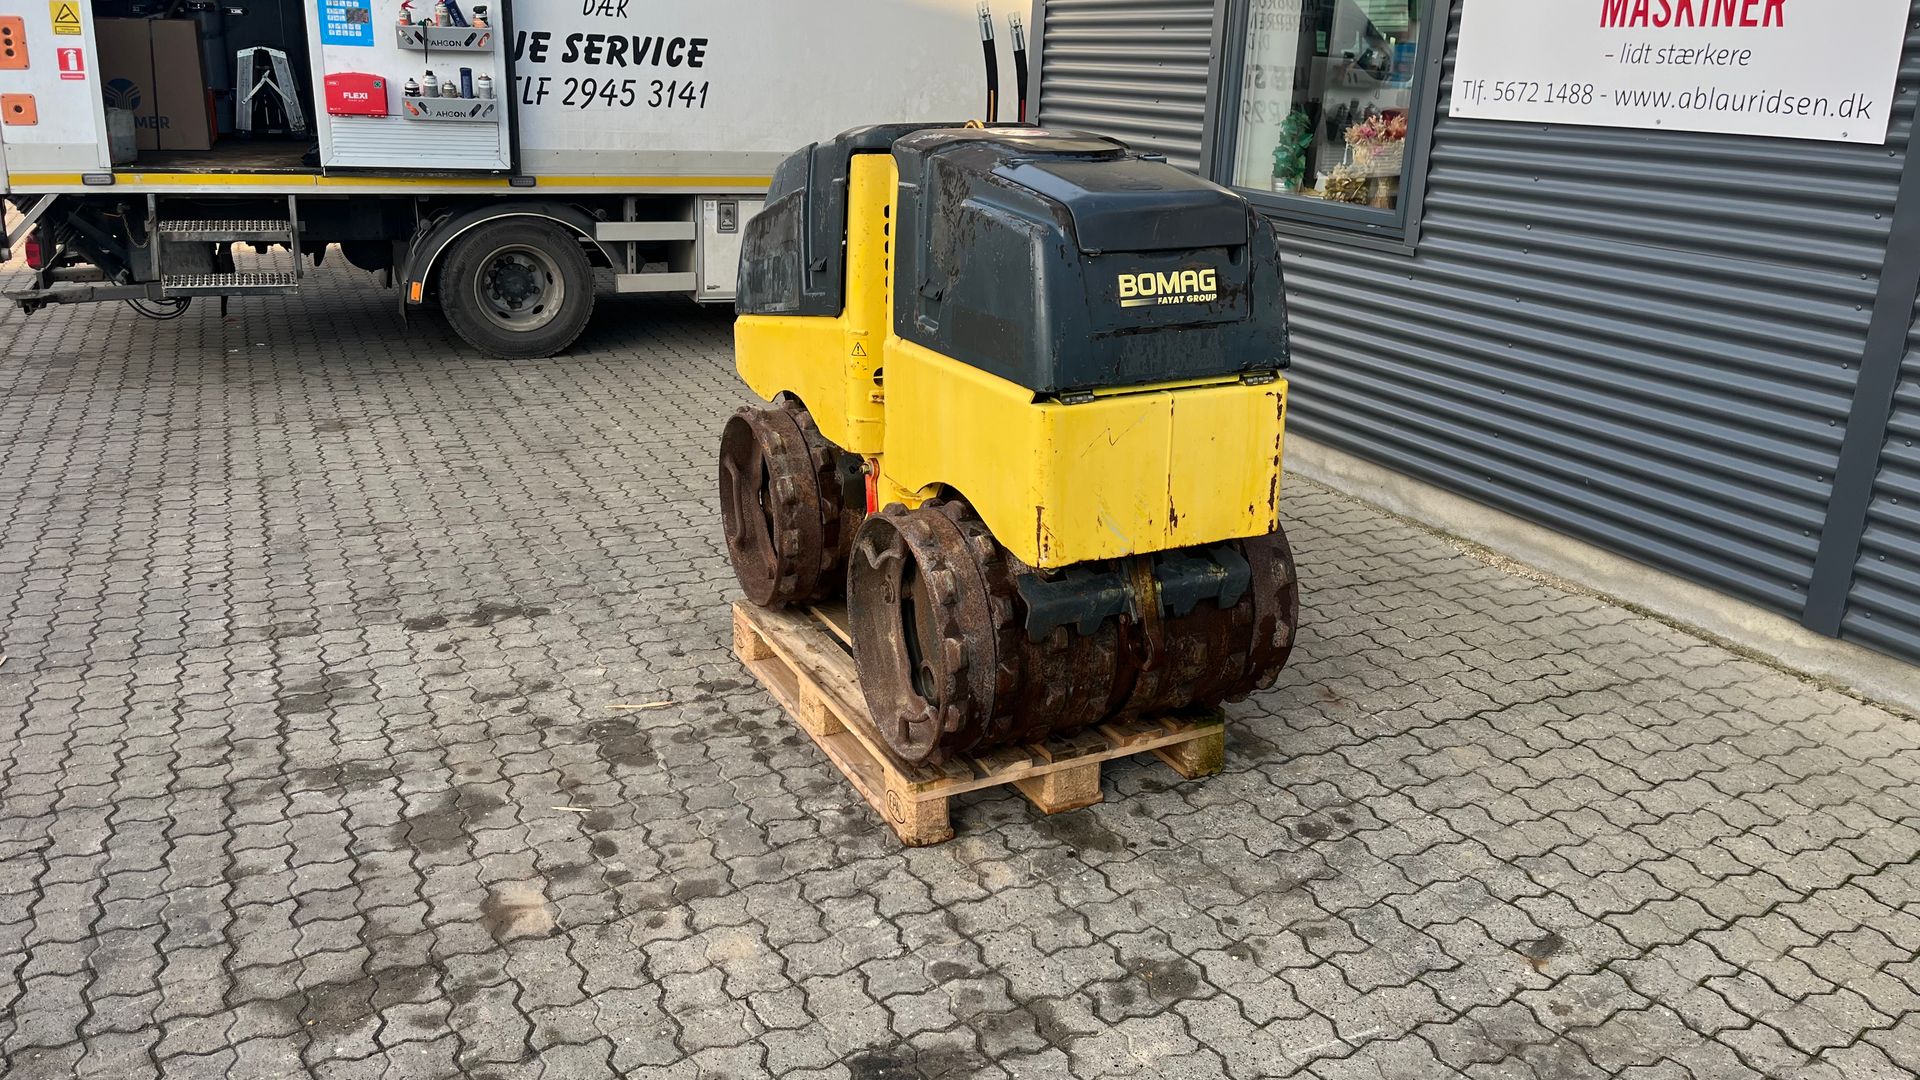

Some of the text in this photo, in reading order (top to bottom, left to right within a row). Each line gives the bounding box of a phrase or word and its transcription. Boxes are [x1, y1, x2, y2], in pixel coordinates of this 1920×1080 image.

[1600, 0, 1786, 27] MASKINER
[562, 33, 708, 68] SERVICE
[1620, 43, 1650, 64] lidt
[1655, 43, 1751, 66] stærkere
[516, 76, 709, 109] LF 2945 3141
[1463, 80, 1487, 105] Tlf.
[1493, 81, 1539, 102] 5672
[1544, 83, 1594, 104] 1488
[1614, 86, 1873, 119] www.ablauridsen.dk
[1118, 269, 1217, 297] BOMAG
[1158, 294, 1217, 304] FAYAT GROUP
